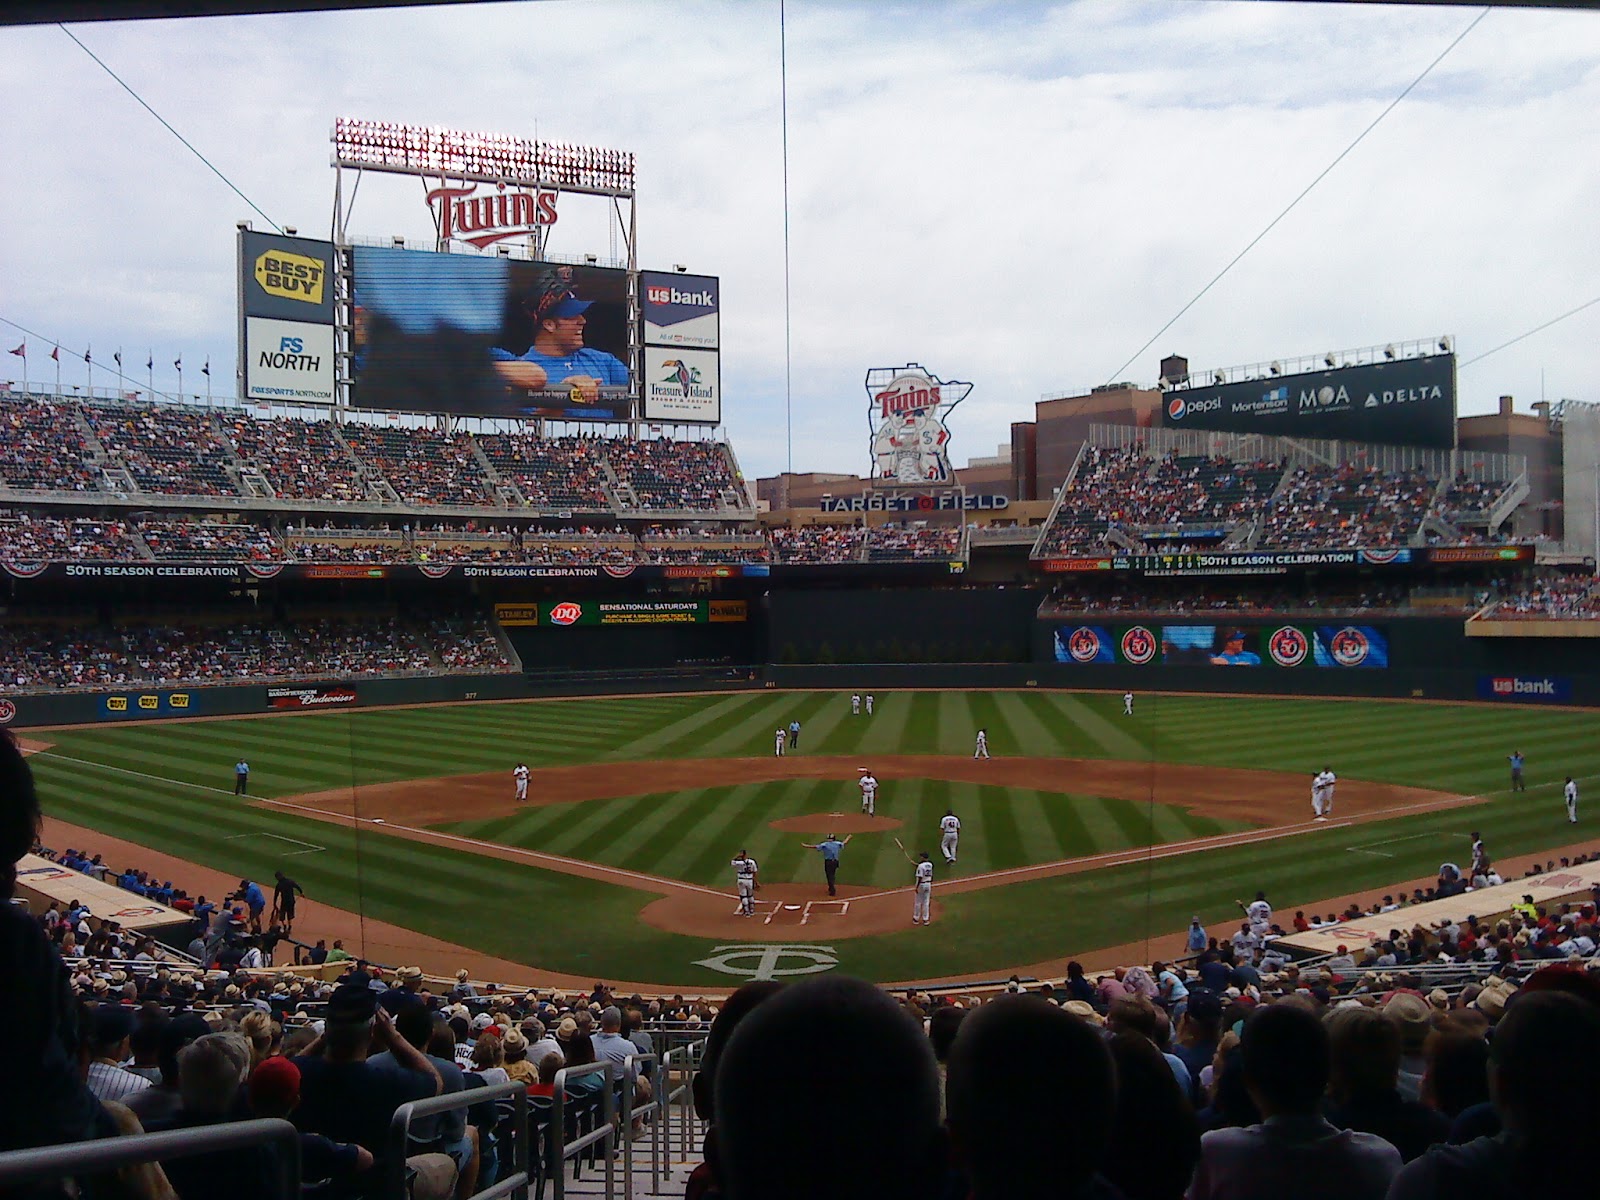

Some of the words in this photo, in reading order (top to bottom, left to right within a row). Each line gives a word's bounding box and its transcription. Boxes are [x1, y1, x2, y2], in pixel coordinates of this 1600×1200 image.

[426, 181, 558, 246] Twins
[265, 257, 321, 281] BEST
[267, 273, 316, 295] BUY
[280, 336, 303, 353] FS
[259, 351, 320, 372] NORTH
[650, 383, 682, 396] Treasure
[690, 385, 713, 398] Island
[1383, 385, 1442, 404] DELTA
[875, 385, 941, 419] Twins
[1187, 396, 1222, 414] pepsi
[1231, 399, 1288, 413] Mortenson
[821, 497, 914, 512] TARGET
[939, 495, 1009, 511] FIELD
[1201, 556, 1228, 565] 50TH
[1231, 556, 1273, 565] SEASON
[1276, 554, 1354, 565] CELEBRATION
[66, 565, 100, 576] 50TH
[104, 567, 154, 576] SEASON
[157, 567, 238, 576] CELEBRATION
[464, 568, 489, 576] 50TH
[529, 568, 598, 576] CELEBRATION
[500, 610, 533, 618] STANLEY
[556, 607, 577, 619] DQ
[1131, 639, 1147, 652] 50
[1281, 641, 1298, 654] 50
[299, 694, 355, 705] Budweiser
